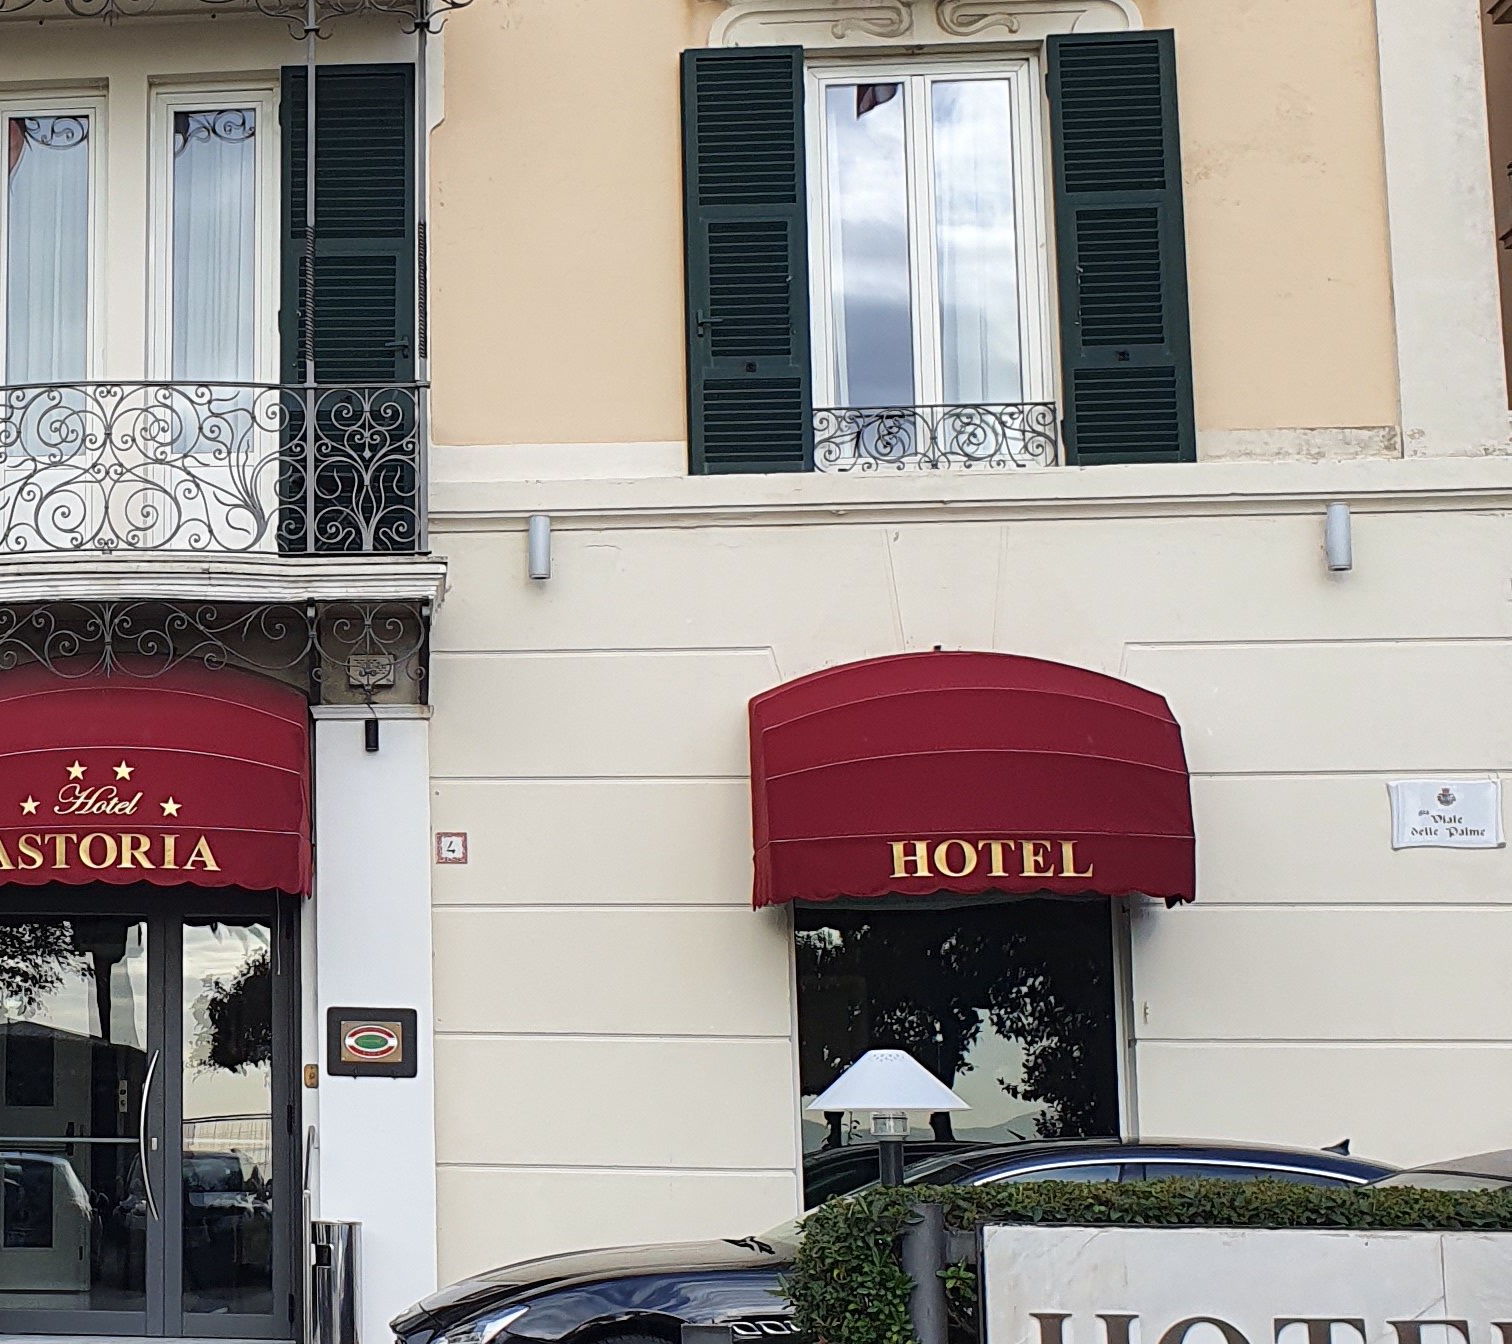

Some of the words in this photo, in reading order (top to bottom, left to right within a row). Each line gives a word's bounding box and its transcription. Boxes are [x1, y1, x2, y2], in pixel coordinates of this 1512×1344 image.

[53, 783, 144, 815] Hotel
[446, 840, 456, 854] 4
[888, 839, 1093, 878] HOTEL
